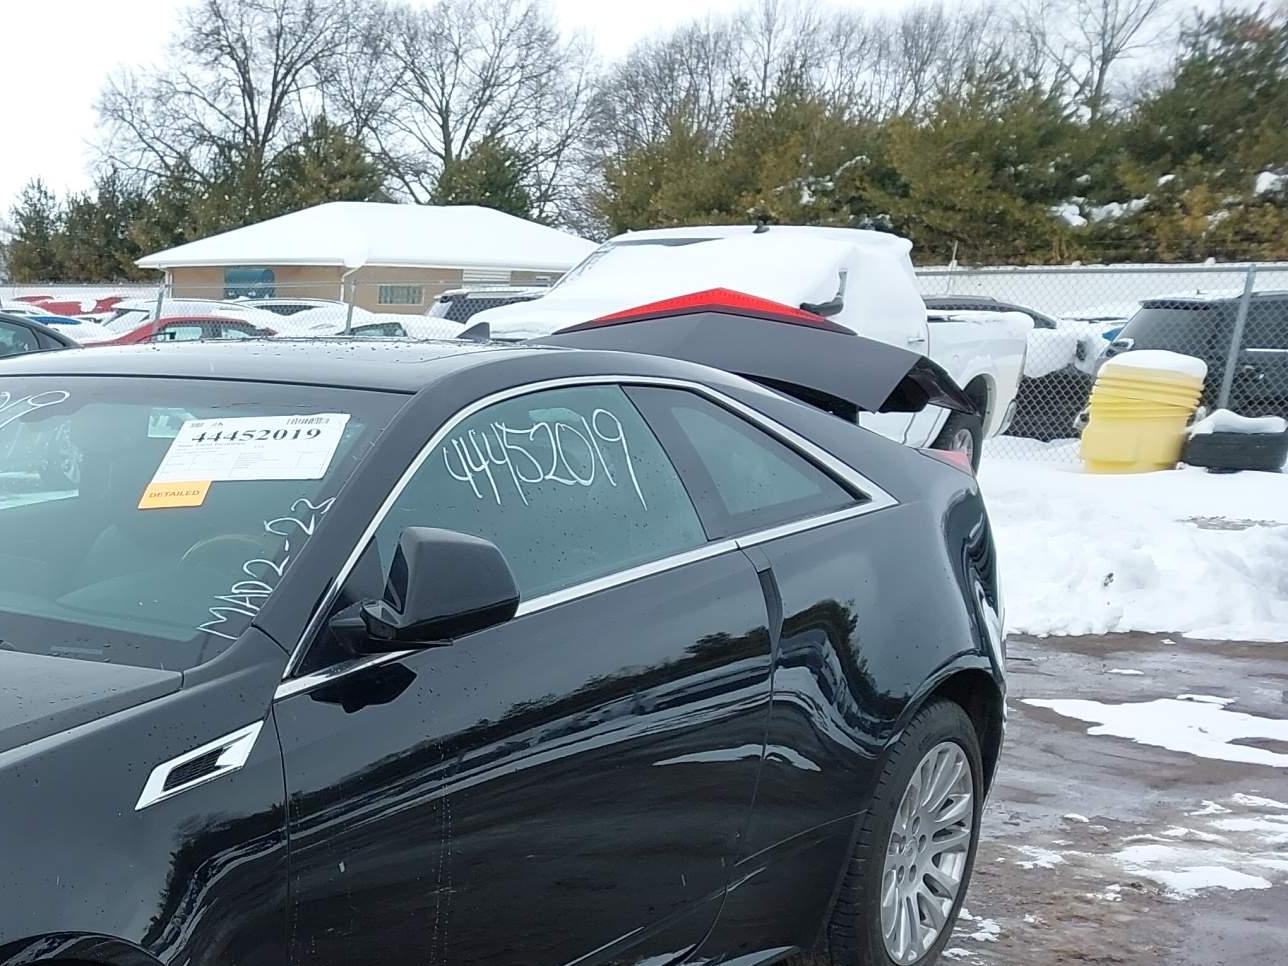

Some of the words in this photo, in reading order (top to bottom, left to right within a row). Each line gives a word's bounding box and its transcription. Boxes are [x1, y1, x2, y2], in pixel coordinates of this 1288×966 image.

[192, 428, 322, 443] 44452019
[443, 408, 648, 511] 44452019
[148, 489, 201, 499] DETAILED
